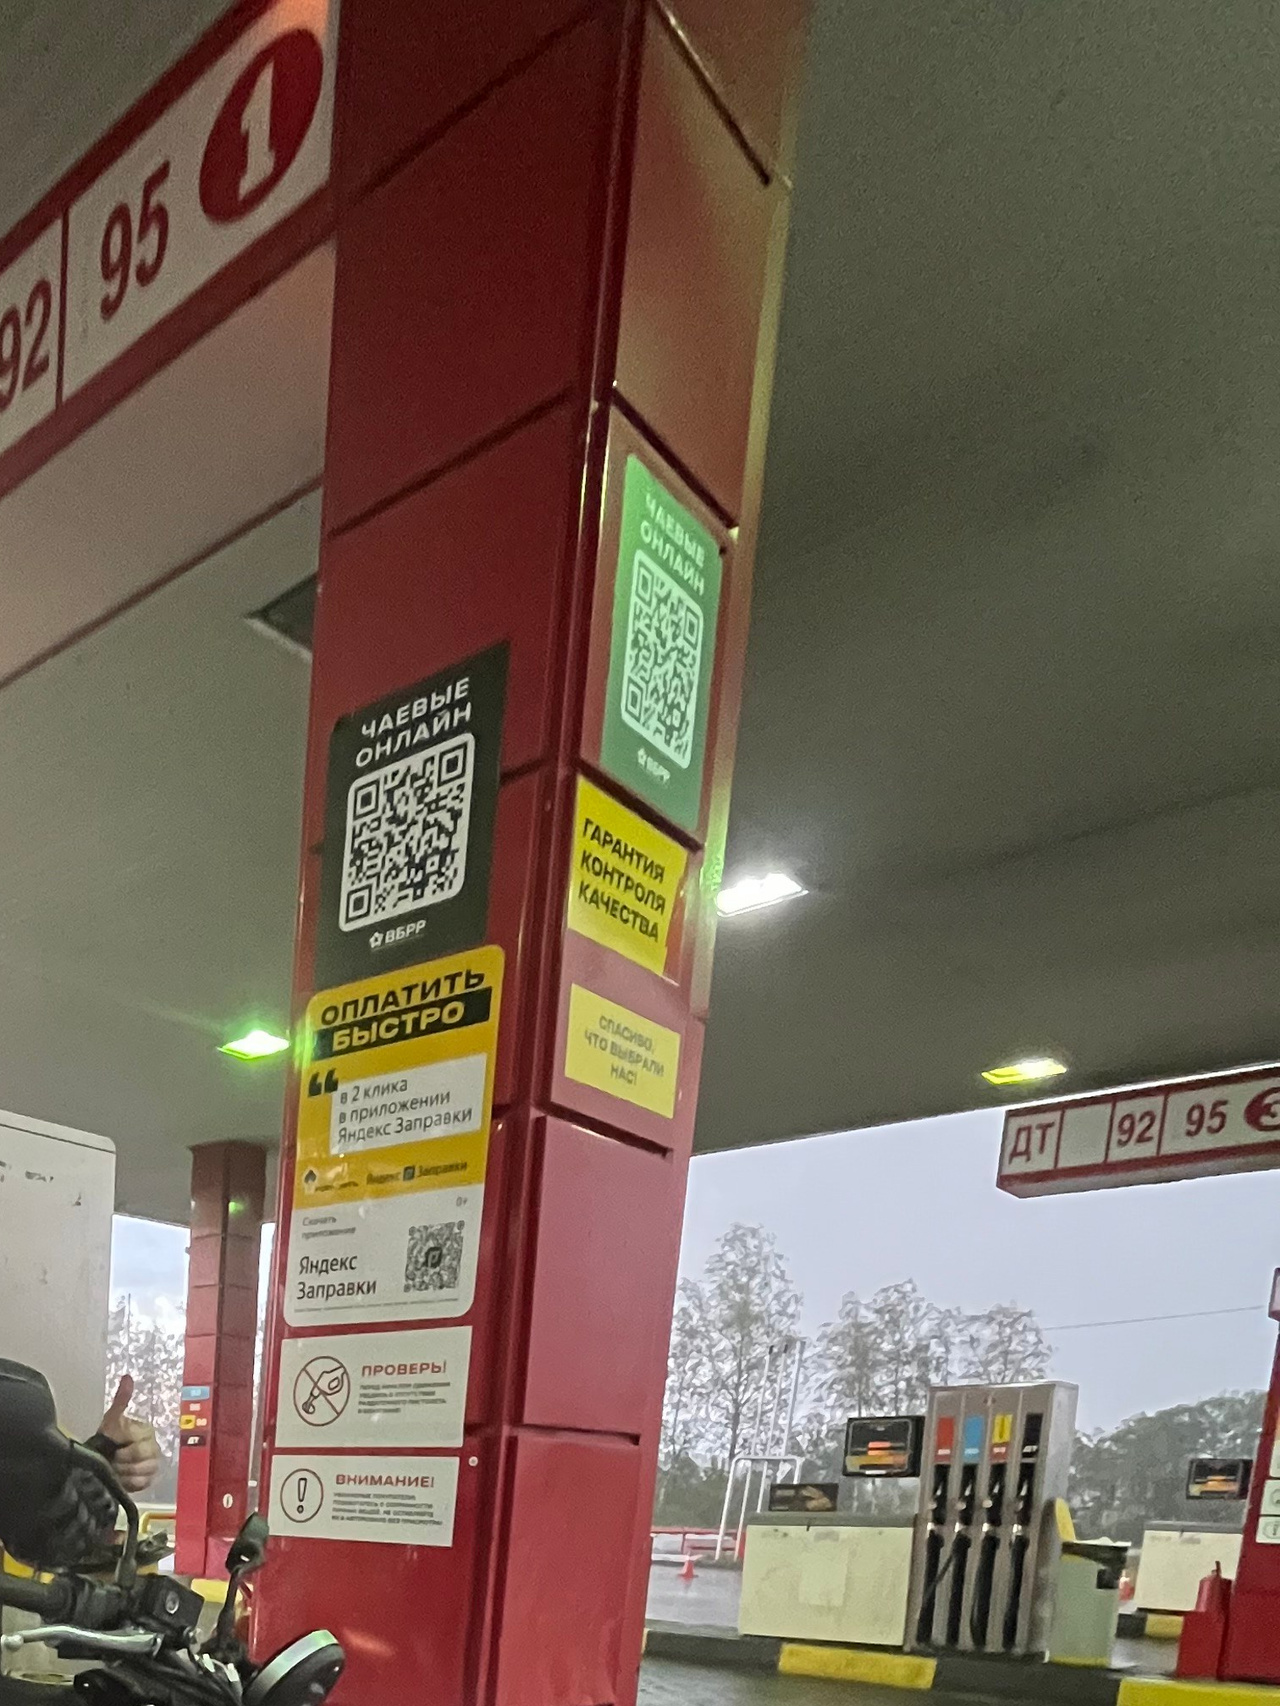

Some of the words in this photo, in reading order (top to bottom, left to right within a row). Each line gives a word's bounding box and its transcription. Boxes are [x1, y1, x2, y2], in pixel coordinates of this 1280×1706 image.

[100, 160, 170, 321] 95
[239, 60, 275, 201] 1
[640, 519, 705, 596] ОНЛАЙН
[646, 493, 705, 569] ЧАЕВЫЕ
[361, 677, 470, 738] ЧАЕВЫЕ
[356, 701, 471, 768] ОНЛАЙН
[584, 818, 665, 883] ГАРАНТИЯ
[580, 850, 666, 915] КОНТРОЛЯ
[385, 919, 426, 943] ВБРР
[579, 881, 659, 942] КАЧЕСТВА
[321, 969, 485, 1025] ОПЛАТИТЬ
[332, 1001, 465, 1051] БЫСТРО
[585, 1029, 608, 1051] ЧТО
[339, 1112, 347, 1124] в
[350, 1091, 451, 1124] приложении
[340, 1091, 348, 1104] в
[351, 1085, 360, 1102] 2
[363, 1079, 408, 1098] клика
[338, 1121, 391, 1144] Яндекс
[396, 1107, 473, 1137] Заправки
[1009, 1121, 1055, 1165] ДТ
[1117, 1110, 1157, 1147] 92
[1185, 1100, 1228, 1137] 95
[296, 1280, 377, 1301] Заправки
[299, 1255, 358, 1277] Яндекс
[362, 1360, 446, 1377] ПРОВЕРЬ!
[335, 1474, 435, 1488] ВНИМАНИЕ!
